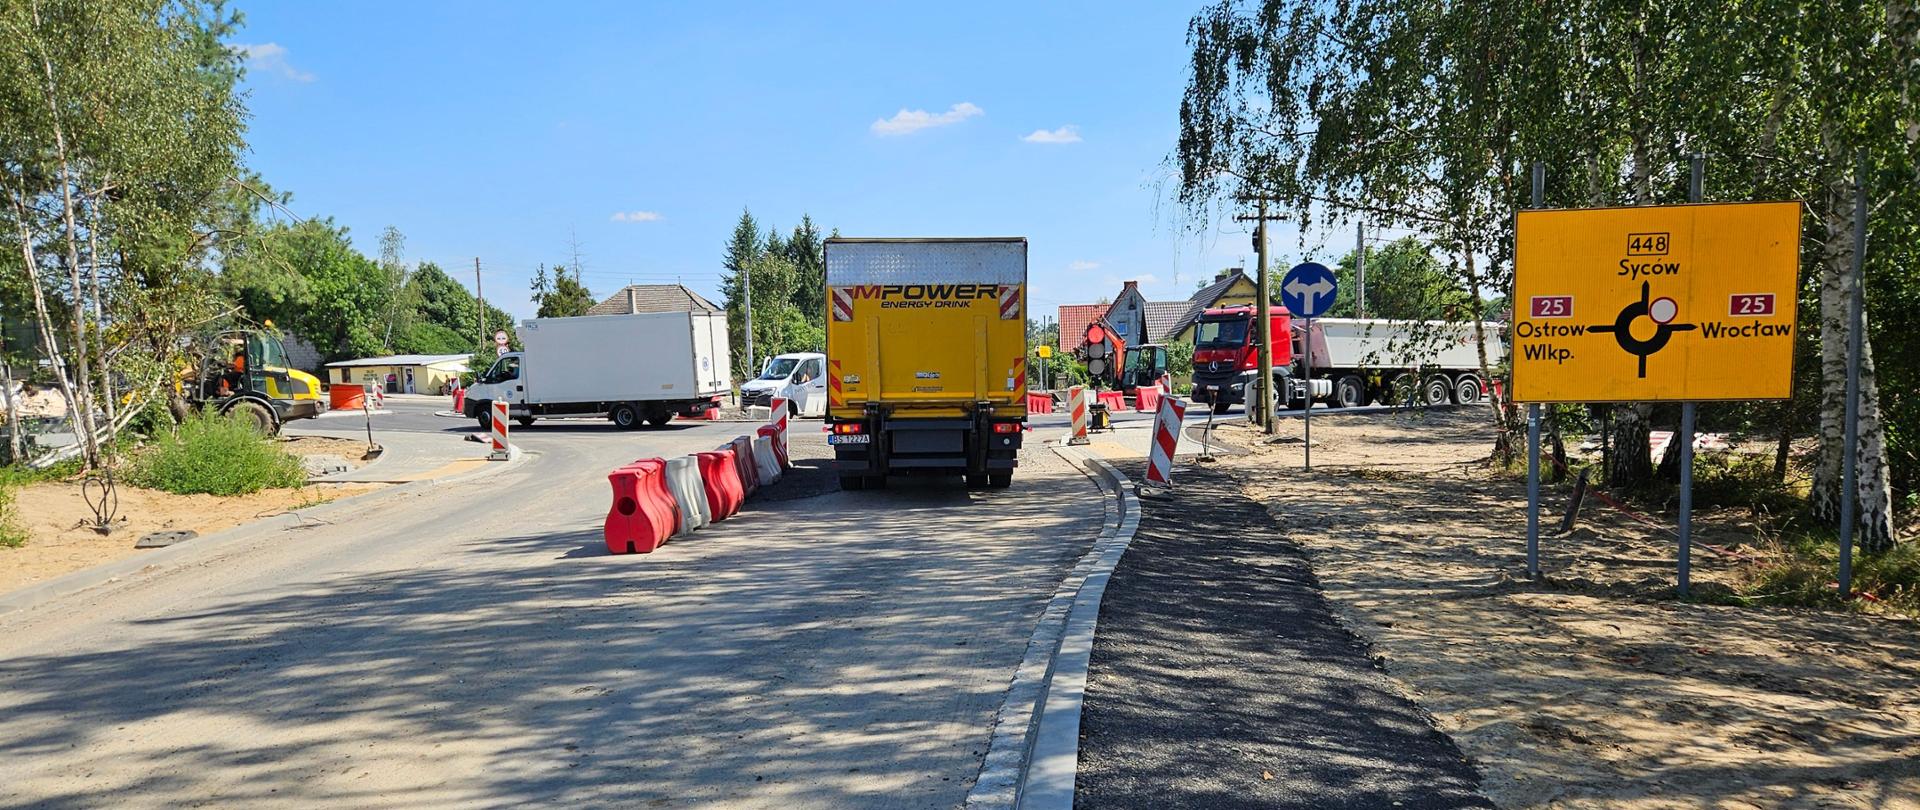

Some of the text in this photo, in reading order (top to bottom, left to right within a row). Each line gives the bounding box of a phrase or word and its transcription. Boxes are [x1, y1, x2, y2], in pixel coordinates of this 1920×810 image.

[1630, 236, 1666, 253] 448
[1618, 258, 1681, 280] Syców
[1540, 299, 1564, 315] 25
[1740, 297, 1766, 313] 25
[1516, 321, 1585, 338] Ostrow
[1701, 319, 1791, 339] Wrocław
[1524, 344, 1575, 364] Wlkp.
